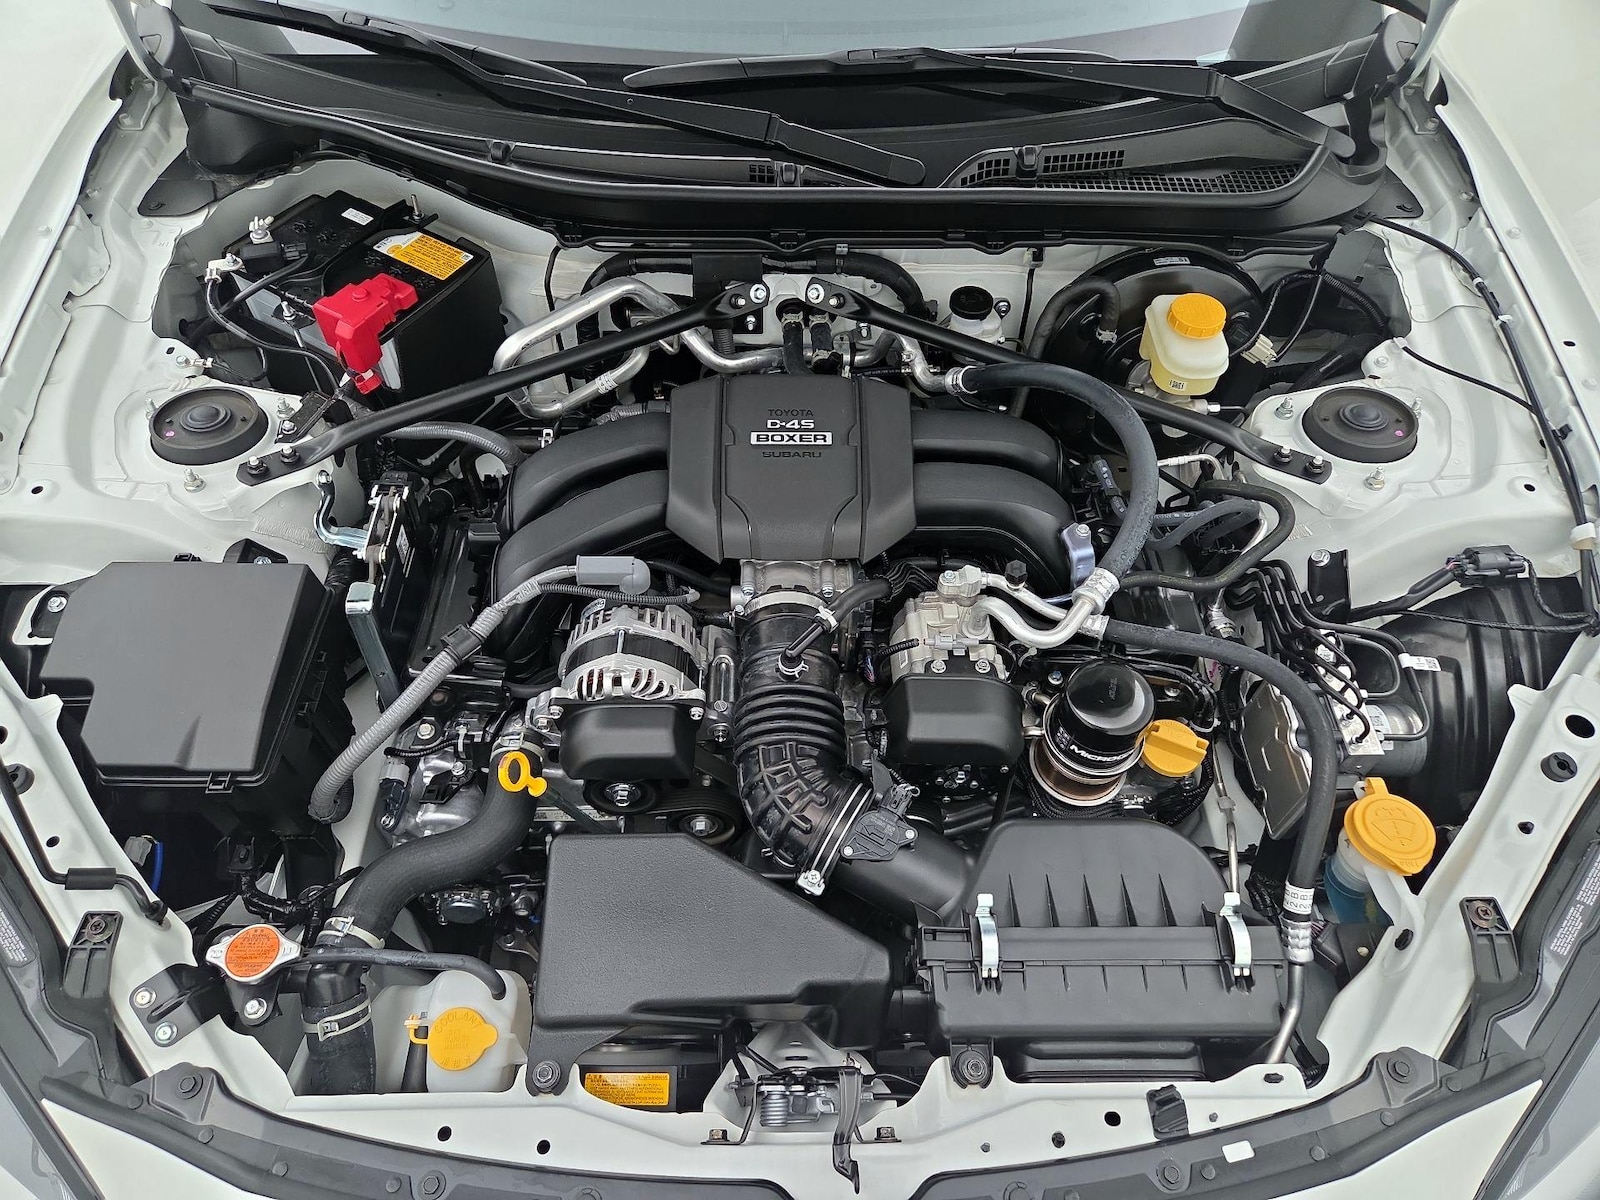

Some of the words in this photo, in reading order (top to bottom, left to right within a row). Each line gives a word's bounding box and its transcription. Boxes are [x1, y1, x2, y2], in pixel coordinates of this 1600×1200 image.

[767, 408, 814, 417] TOYOTA
[756, 434, 827, 443] BOXER
[434, 1011, 483, 1034] COOLANT
